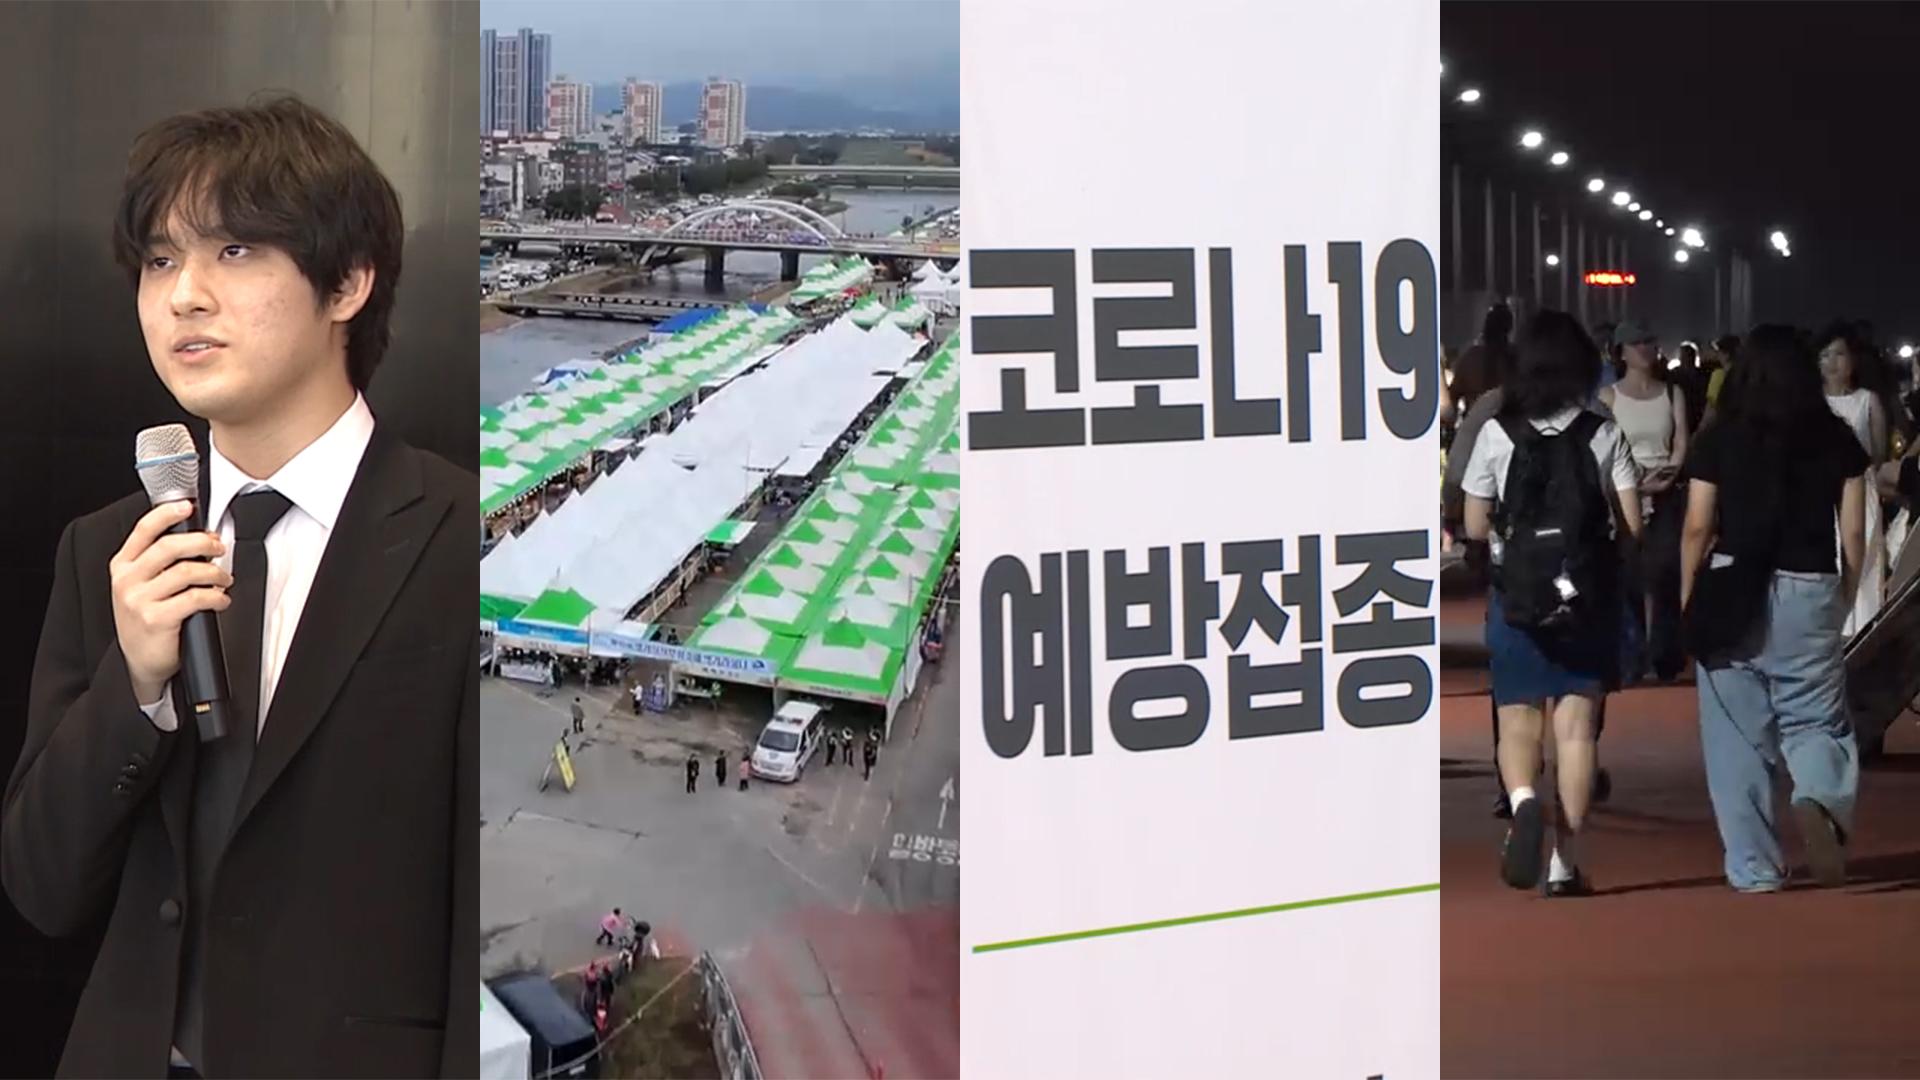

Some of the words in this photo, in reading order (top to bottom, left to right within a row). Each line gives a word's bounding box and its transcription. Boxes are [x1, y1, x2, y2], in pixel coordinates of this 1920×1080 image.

[967, 238, 1440, 451] 코로나19
[980, 529, 1436, 760] 예방접종
[888, 832, 960, 866] 일방통
